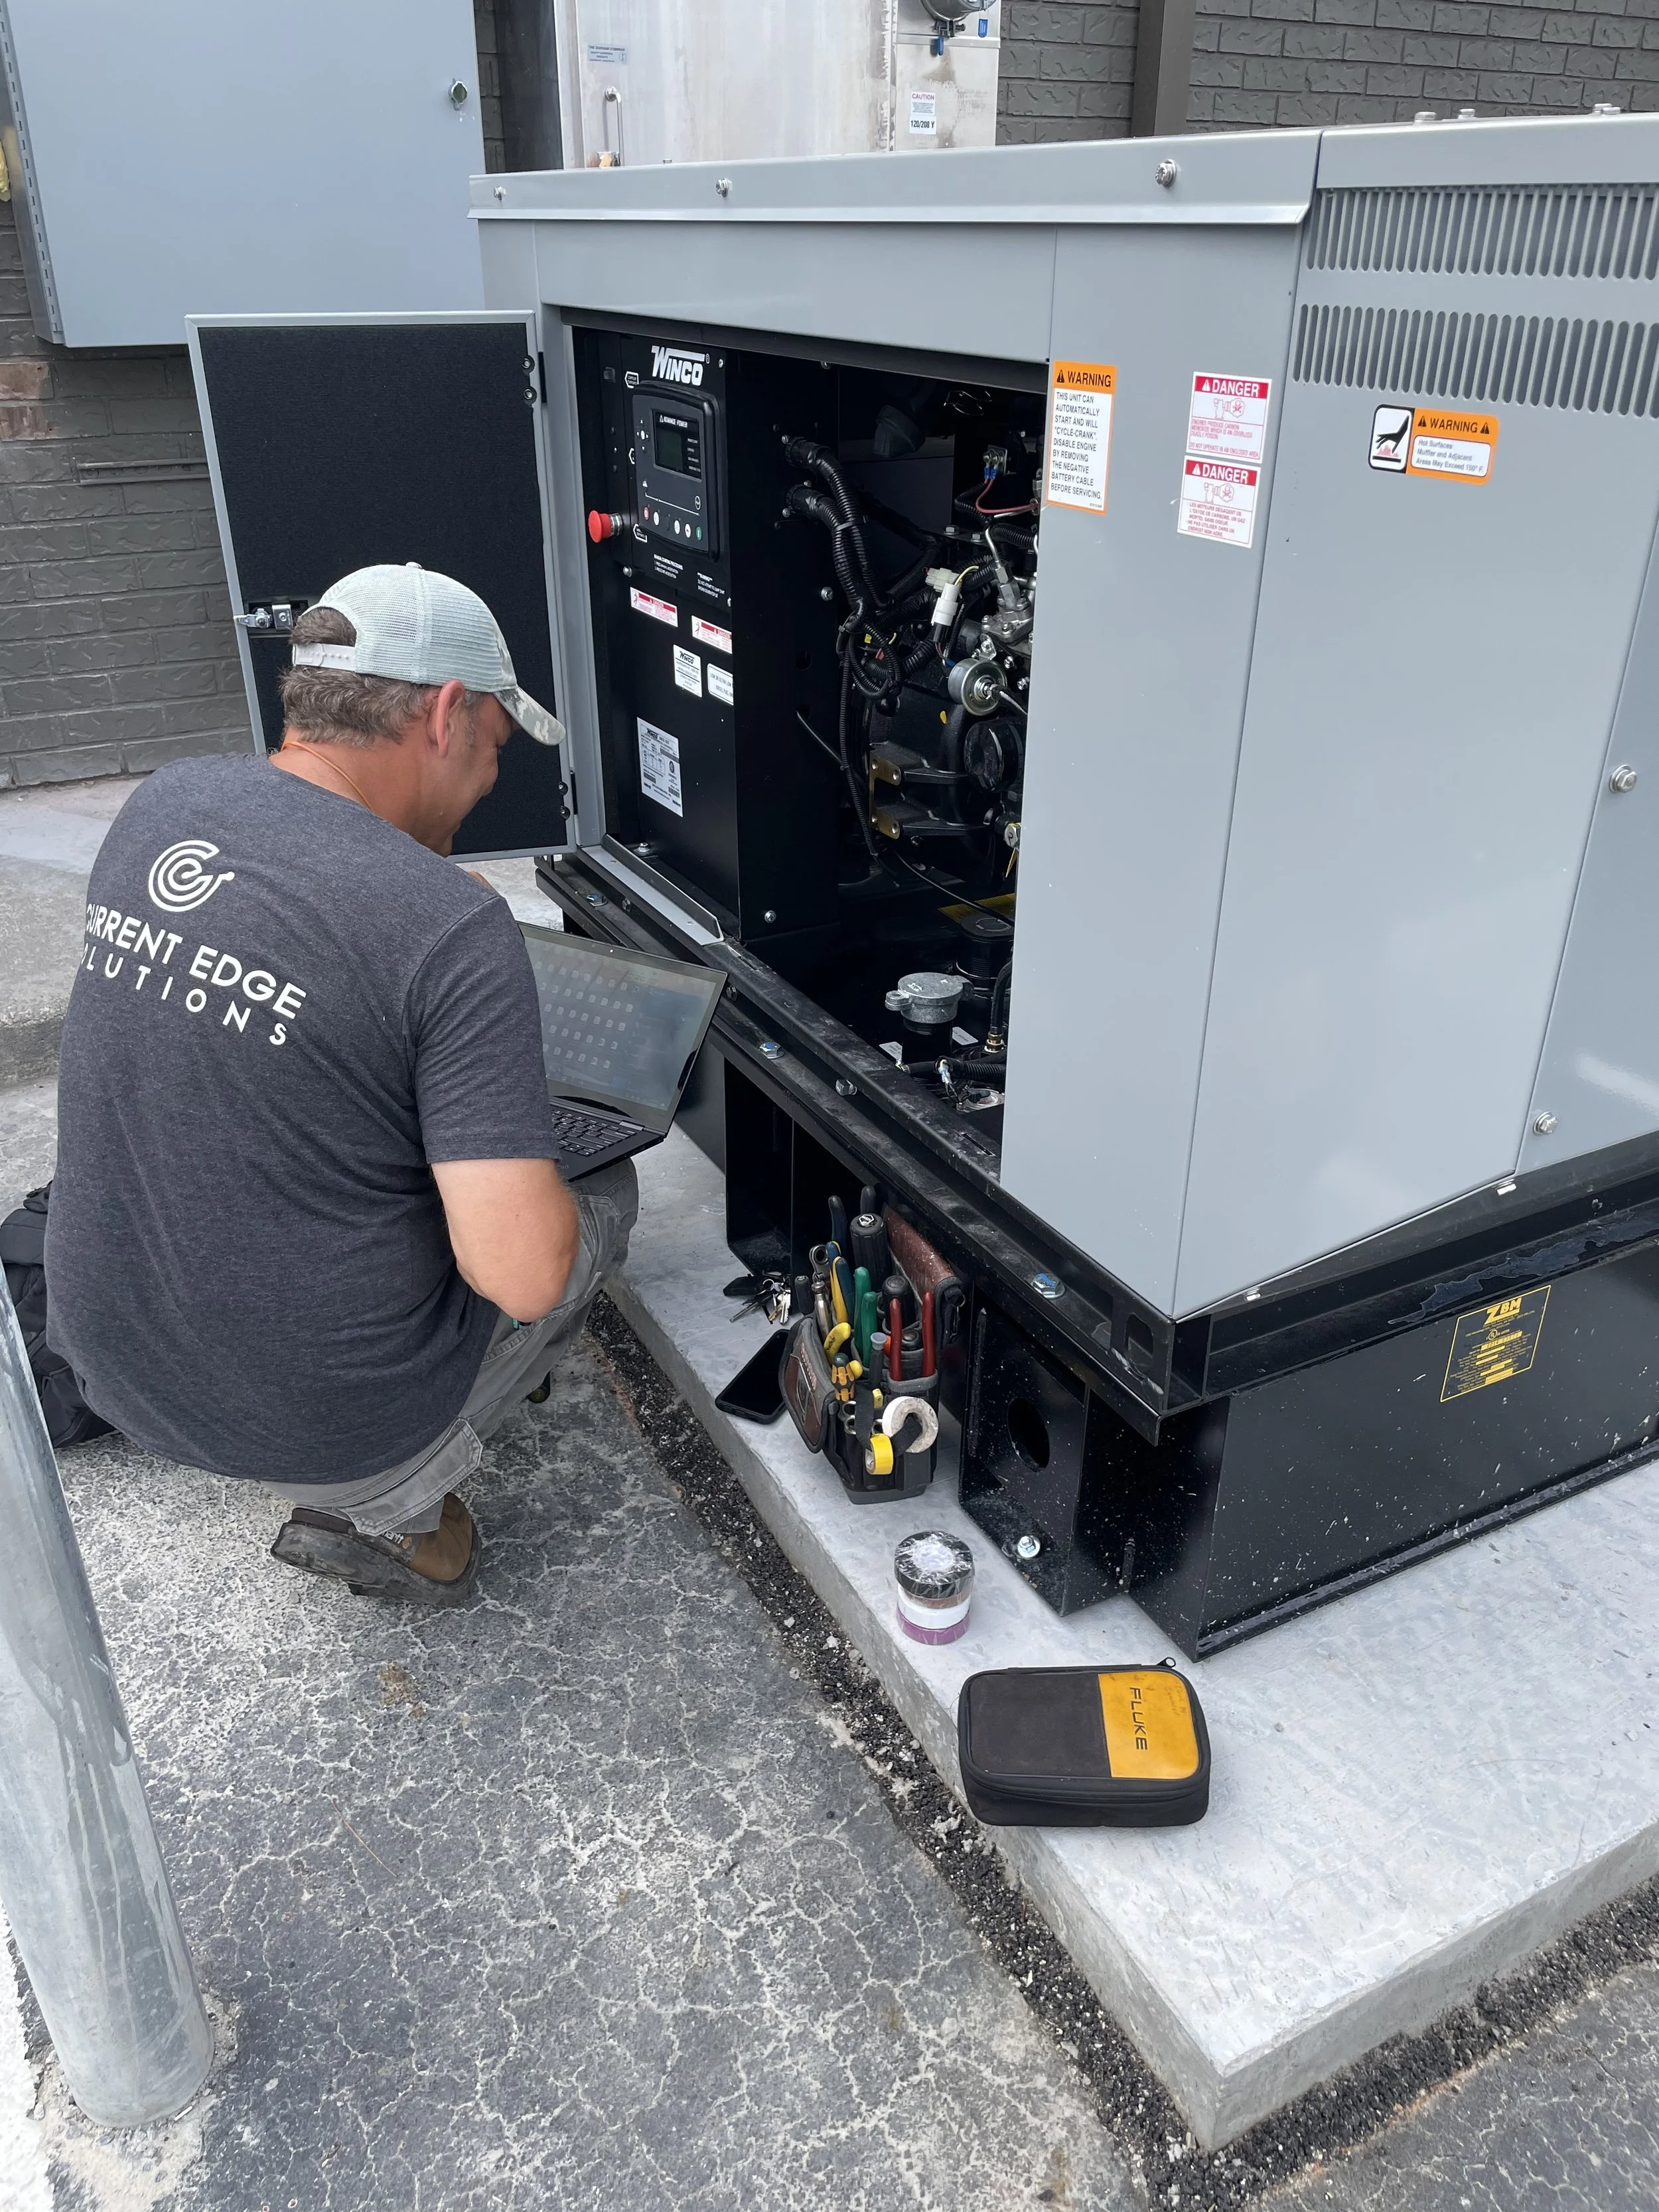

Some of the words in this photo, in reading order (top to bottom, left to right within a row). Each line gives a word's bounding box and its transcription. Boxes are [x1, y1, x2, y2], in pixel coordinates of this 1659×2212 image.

[911, 120, 930, 129] 120/208
[651, 345, 705, 386] WINCO
[1068, 370, 1112, 388] WARNING
[1212, 379, 1260, 398] DANGER
[1056, 392, 1068, 401] THIS
[1069, 393, 1082, 402] UNIT
[1082, 395, 1094, 404] CAN
[1056, 404, 1100, 416] AUTOMATICALLY
[1054, 415, 1072, 425] START
[1072, 417, 1084, 426] AND
[1085, 419, 1098, 428] WILL
[1430, 418, 1478, 433] WARNING
[1053, 438, 1076, 449] DISABLE
[1076, 441, 1097, 451] ENGINE
[1429, 440, 1453, 449] Surfaces
[1061, 451, 1089, 462] REMOVING
[1448, 452, 1472, 461] Adjacent
[1052, 460, 1062, 469] THE
[1063, 463, 1089, 474] NEGATIVE
[1445, 461, 1465, 470] Exceed
[1051, 472, 1075, 482] BATTERY
[1076, 476, 1094, 486] CABLE
[1202, 464, 1249, 484] DANGER
[1050, 483, 1071, 494] BEFORE
[1072, 486, 1102, 499] SERVICING.
[680, 650, 695, 664] WINCO
[188, 944, 307, 1019] EDGE
[81, 943, 287, 1045] LUTIONS
[1484, 1297, 1523, 1325] ZBM
[1129, 1687, 1148, 1751] FLUKE
